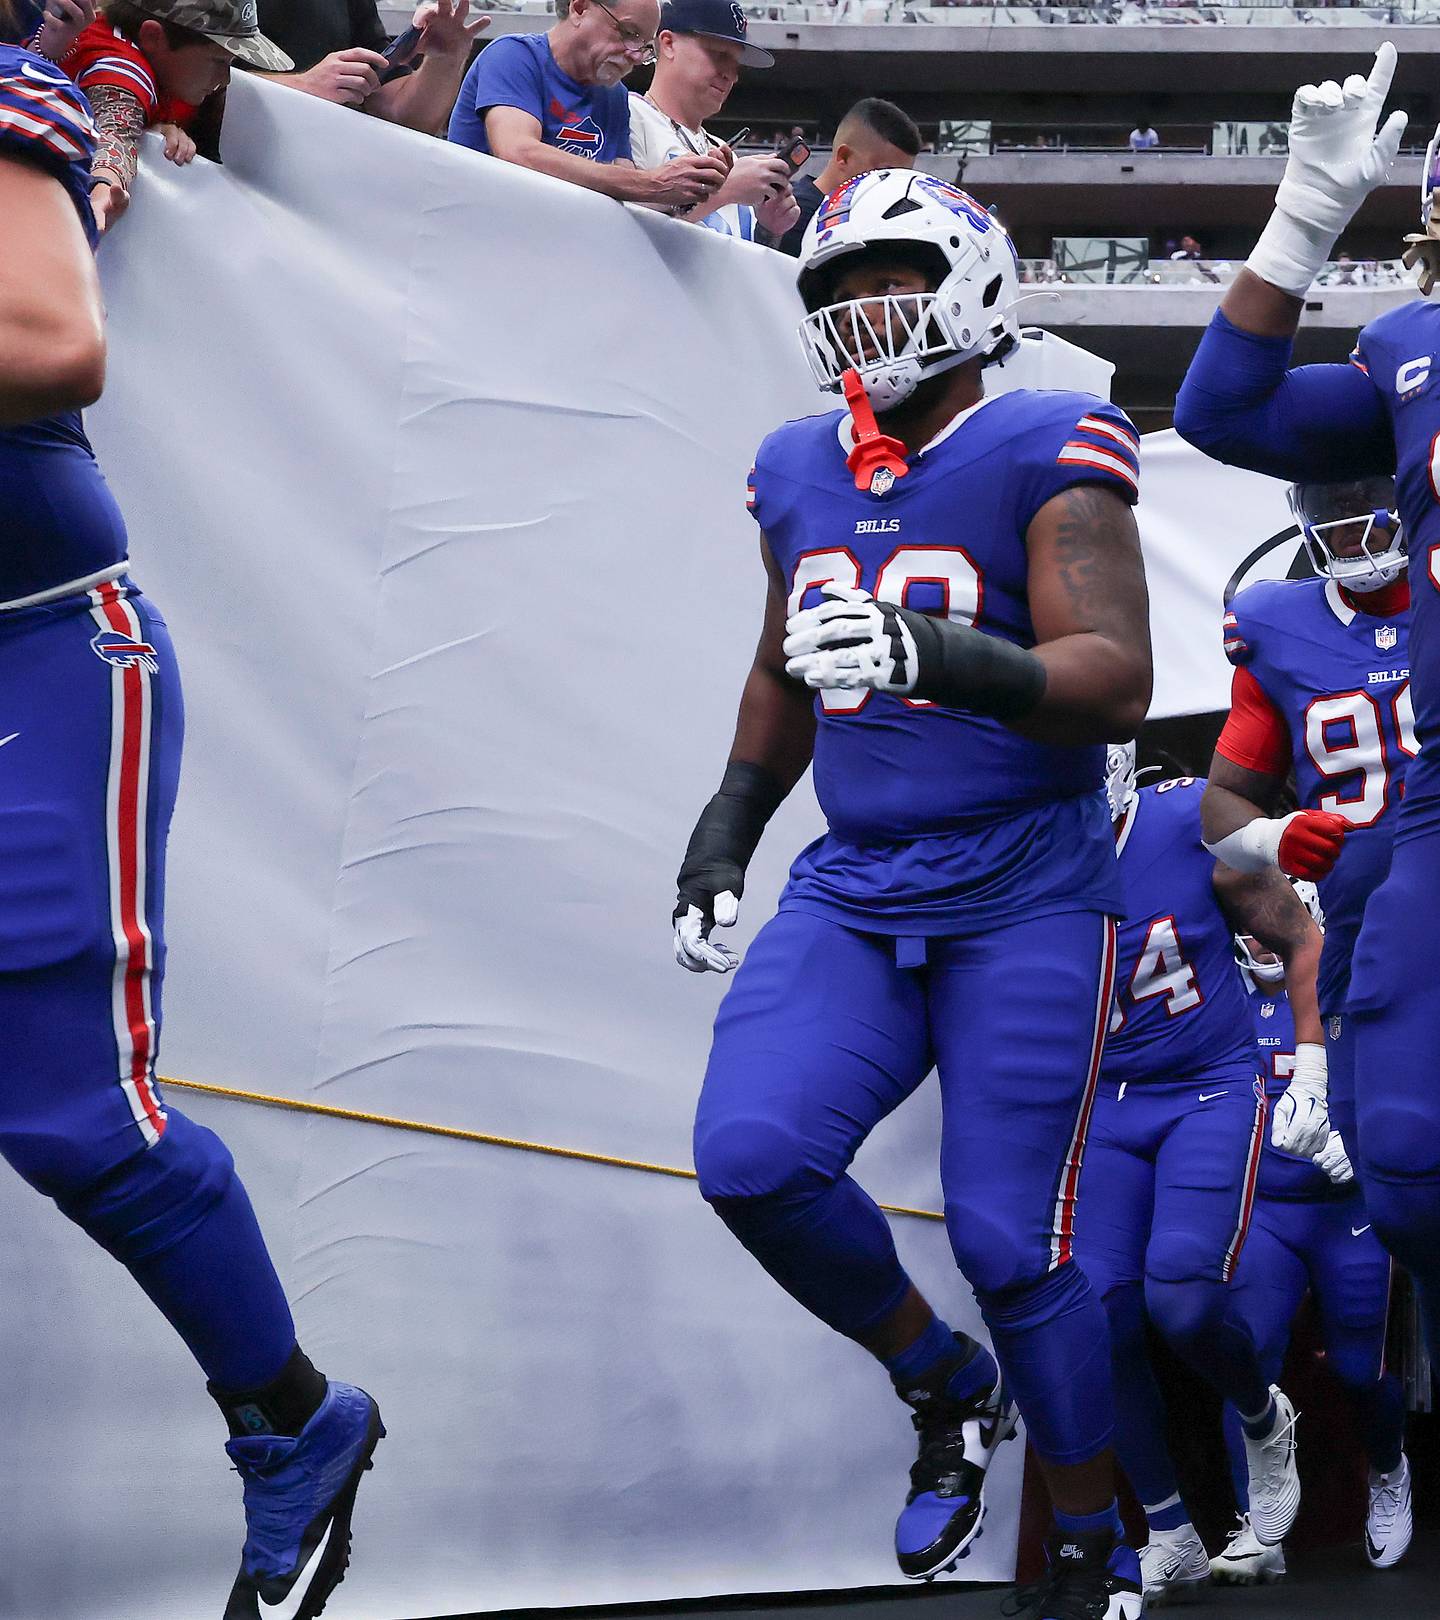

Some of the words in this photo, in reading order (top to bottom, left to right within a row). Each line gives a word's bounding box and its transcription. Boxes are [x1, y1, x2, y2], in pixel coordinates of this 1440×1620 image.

[1396, 356, 1432, 394] C
[854, 518, 900, 534] BILLS
[1367, 669, 1410, 684] BILLS
[1108, 914, 1204, 1036] 4
[1062, 1543, 1078, 1553] NIKE
[1071, 1551, 1084, 1559] AIR
